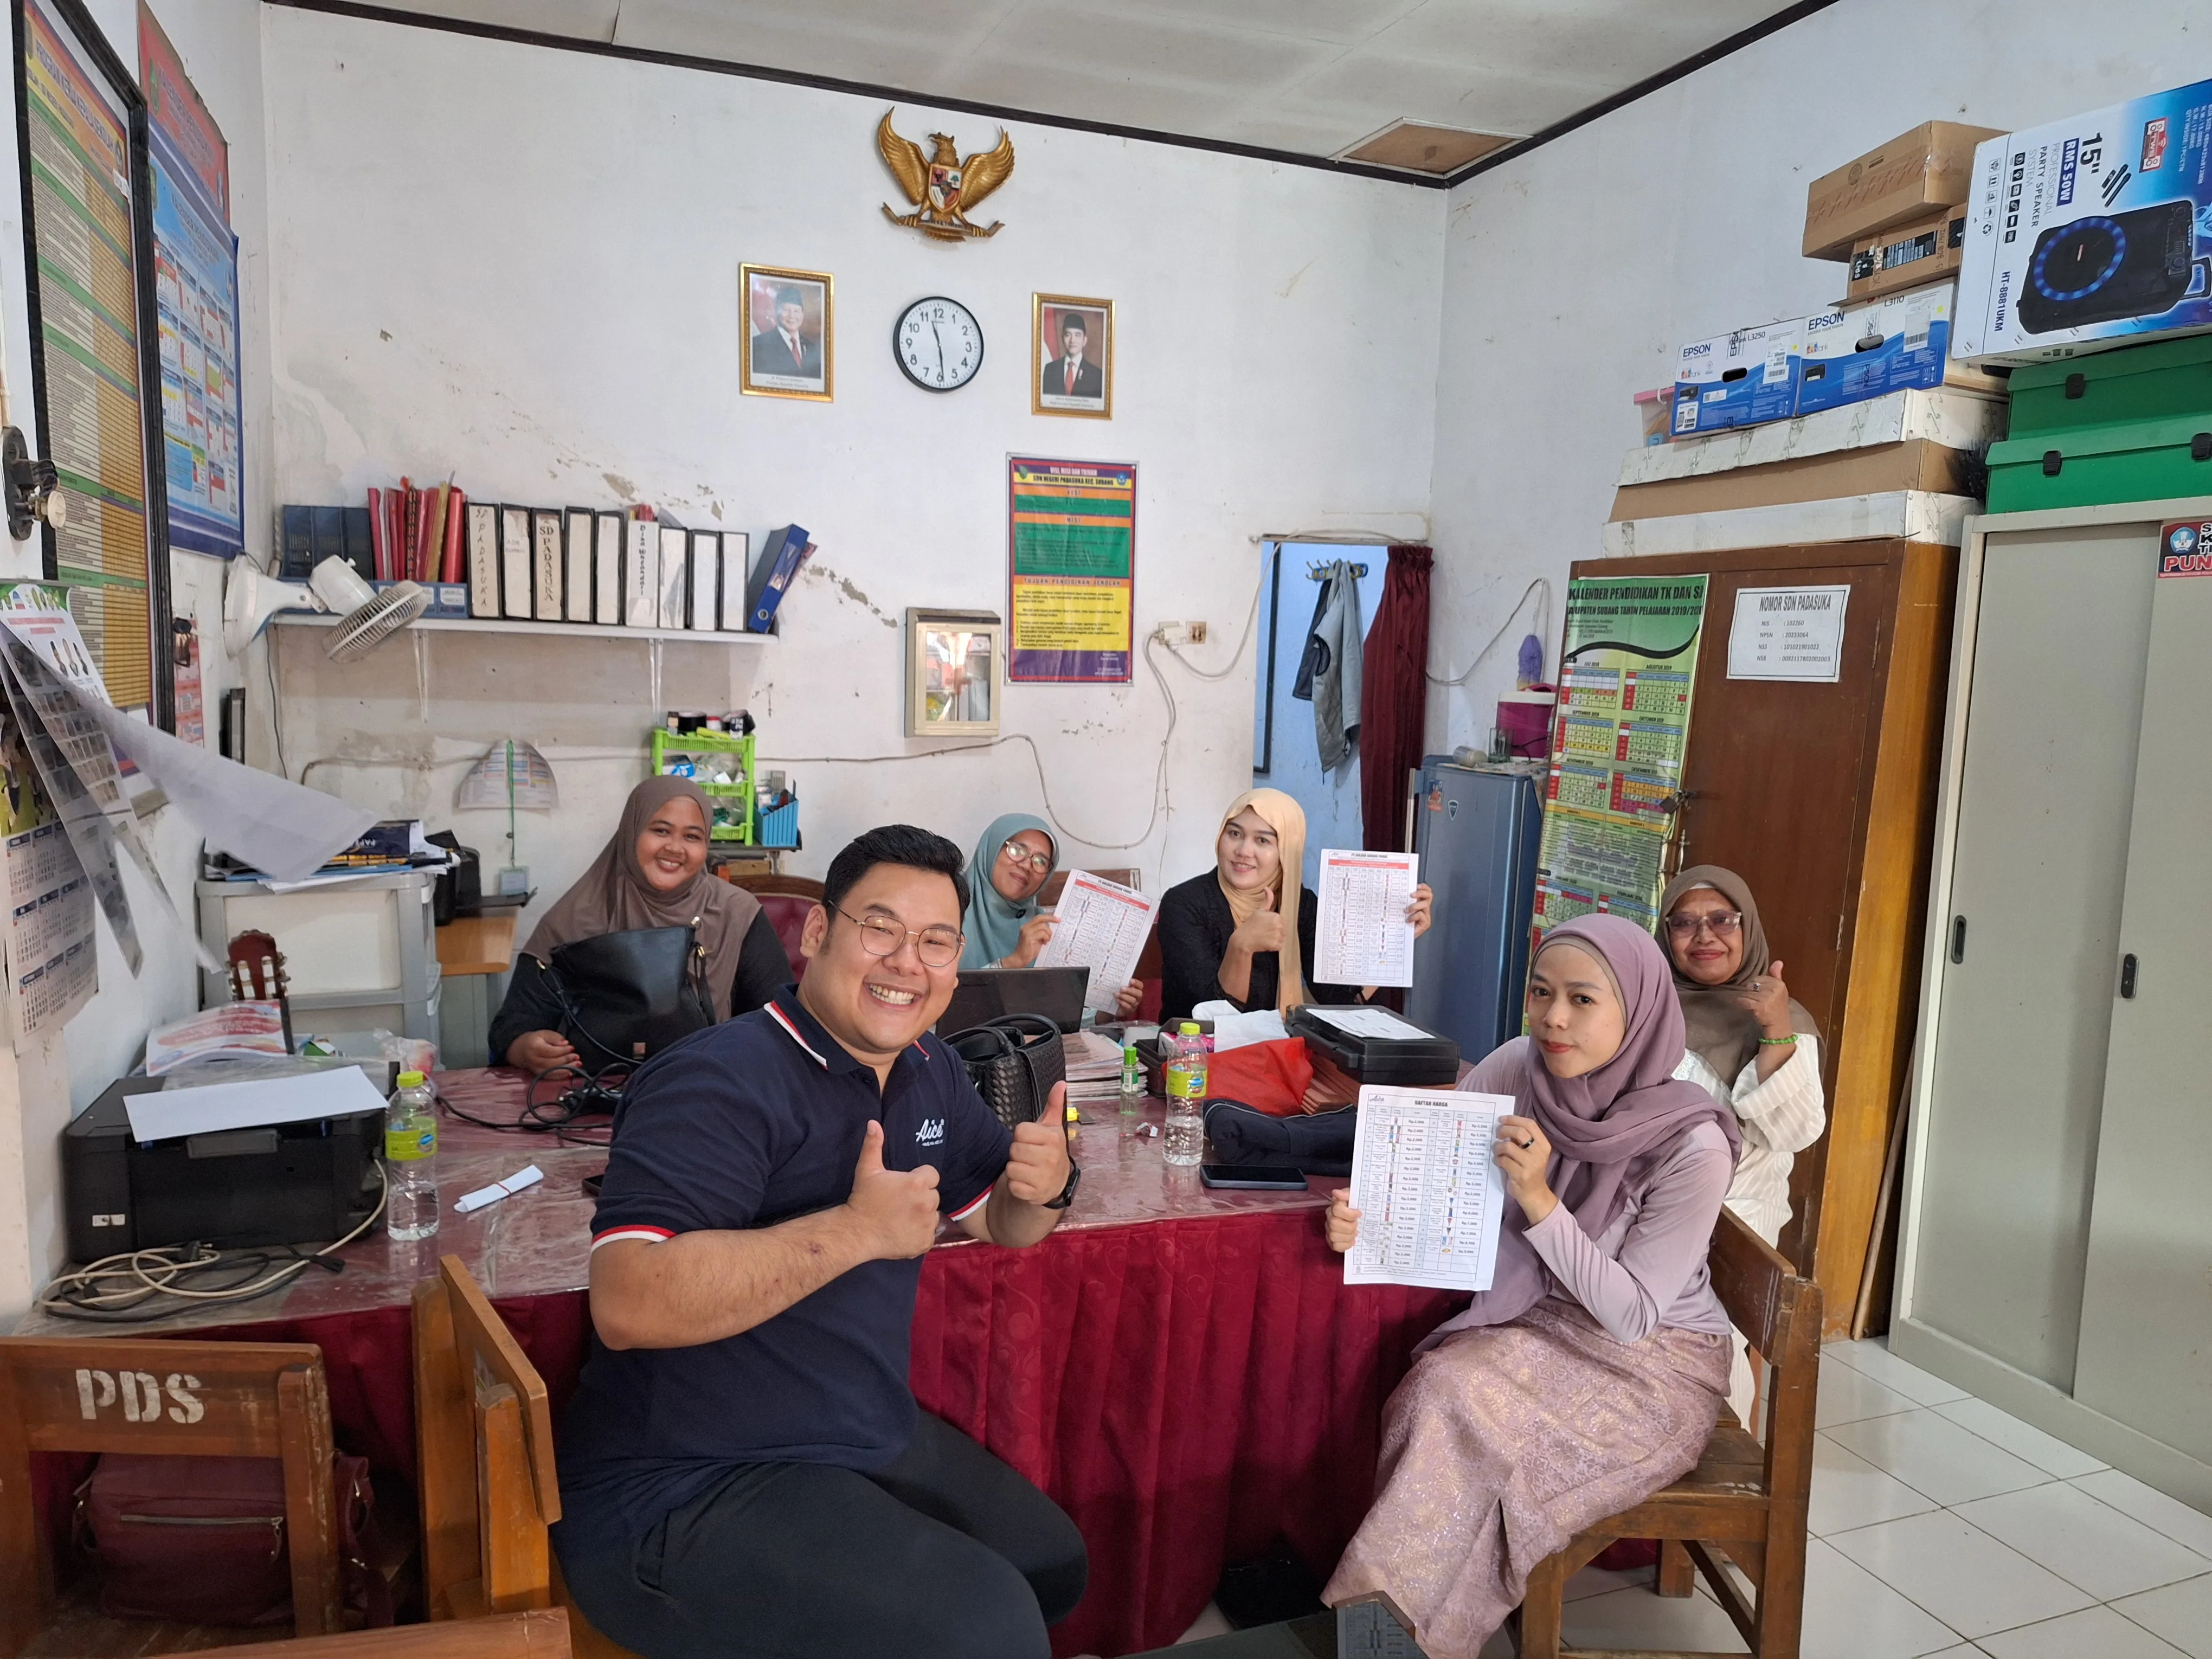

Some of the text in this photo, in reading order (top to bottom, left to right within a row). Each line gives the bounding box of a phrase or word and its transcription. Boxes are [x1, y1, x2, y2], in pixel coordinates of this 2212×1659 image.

[2025, 149, 2037, 187] SYSTEM
[2059, 140, 2077, 201] RMS 50W
[2044, 143, 2060, 215] PROFESSIONAL
[2031, 145, 2048, 227] PARTY SPEAKER
[1884, 295, 1905, 307] L3110
[1994, 271, 2010, 332] HT-8881UKM
[920, 312, 929, 322] 11
[934, 308, 944, 318] 12
[951, 314, 956, 324] 1
[1808, 311, 1845, 331] EPSON
[909, 323, 920, 333] 10
[962, 325, 968, 336] 2
[1747, 331, 1766, 342] L3250
[905, 338, 913, 349] 9
[965, 342, 972, 352] 3
[1683, 343, 1711, 358] EPSON
[910, 354, 917, 365] 8
[961, 357, 968, 368] 4
[923, 367, 929, 377] 7
[936, 372, 943, 382] 6
[951, 368, 958, 378] 5
[539, 526, 554, 536] SD
[1568, 587, 1609, 600] KALENDER
[1610, 586, 1659, 600] PENDIDIKAN
[1661, 587, 1673, 600] TK
[1674, 586, 1692, 599] DAN
[1759, 594, 1832, 612] NOMOR SDN PADASUKA
[1597, 606, 1619, 615] SUBANG
[1639, 605, 1670, 615] PELAJARAN
[916, 1118, 944, 1142] Aice
[75, 1368, 204, 1424] PDS
